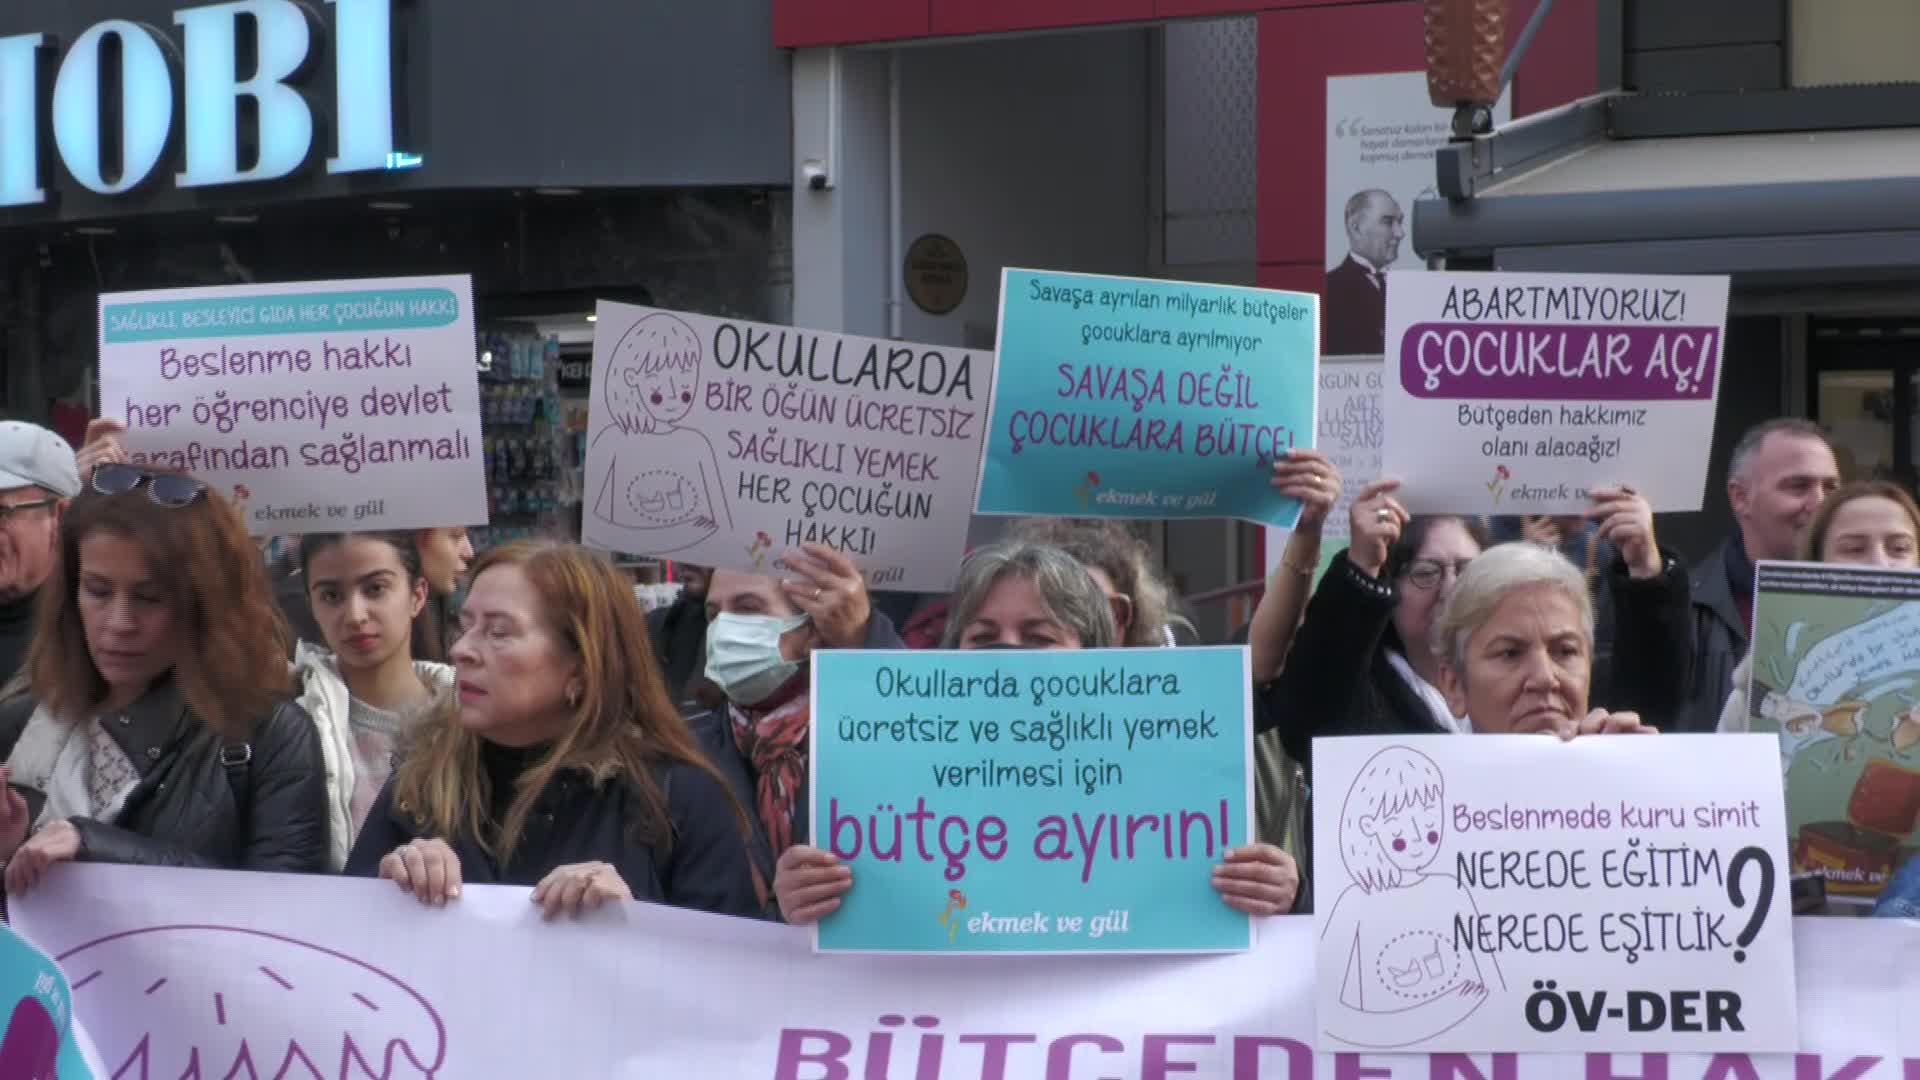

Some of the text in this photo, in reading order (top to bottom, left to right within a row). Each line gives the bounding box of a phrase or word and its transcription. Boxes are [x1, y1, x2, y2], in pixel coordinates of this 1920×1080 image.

[0, 0, 394, 207] OBI
[300, 303, 330, 321] HER
[1028, 278, 1309, 325] Savaşa ayrılan milyarlık bütçeler
[1440, 285, 1686, 322] ABARTMIYORUZ!
[160, 337, 412, 380] Beslenme hakkı
[712, 322, 975, 400] OKULLARDA
[1081, 322, 1264, 356] çocuklara ayrılmıyor
[1416, 329, 1714, 394] ÇOCUKLAR AÇ!
[126, 382, 453, 434] her öğrenciye devlet
[705, 376, 975, 440] BİR ÖĞÜN ÜCRETSİZ
[1056, 363, 1260, 414] SAVAŞA DEĞİL
[1008, 410, 1185, 454] ÇOCUKLARA
[1457, 403, 1648, 431] Bütçeden hakkımız
[128, 429, 471, 474] arafından sağlanmalı
[727, 427, 940, 482] SAĞLIKLI YEMEK
[1481, 434, 1621, 464] olanı alacağız!
[254, 499, 386, 521] ekmek ve gül
[737, 471, 933, 519] HER ÇOCUĞUN
[1510, 483, 1571, 501] ekmek
[874, 666, 1180, 706] Okullarda çocuklara
[838, 710, 1219, 751] ücretsiz ve sağlıklı yemek
[932, 759, 1123, 796] verilmesi için
[1453, 800, 1760, 833] Beslenmede kuru simit
[829, 796, 1010, 882] bütçe
[1456, 837, 1723, 890] NEREDE EĞİTİM
[967, 909, 1130, 938] ekmek ve gül
[1454, 906, 1733, 964] NEREDE EŞİTLİK
[1525, 979, 1746, 1032] ÖV-DER
